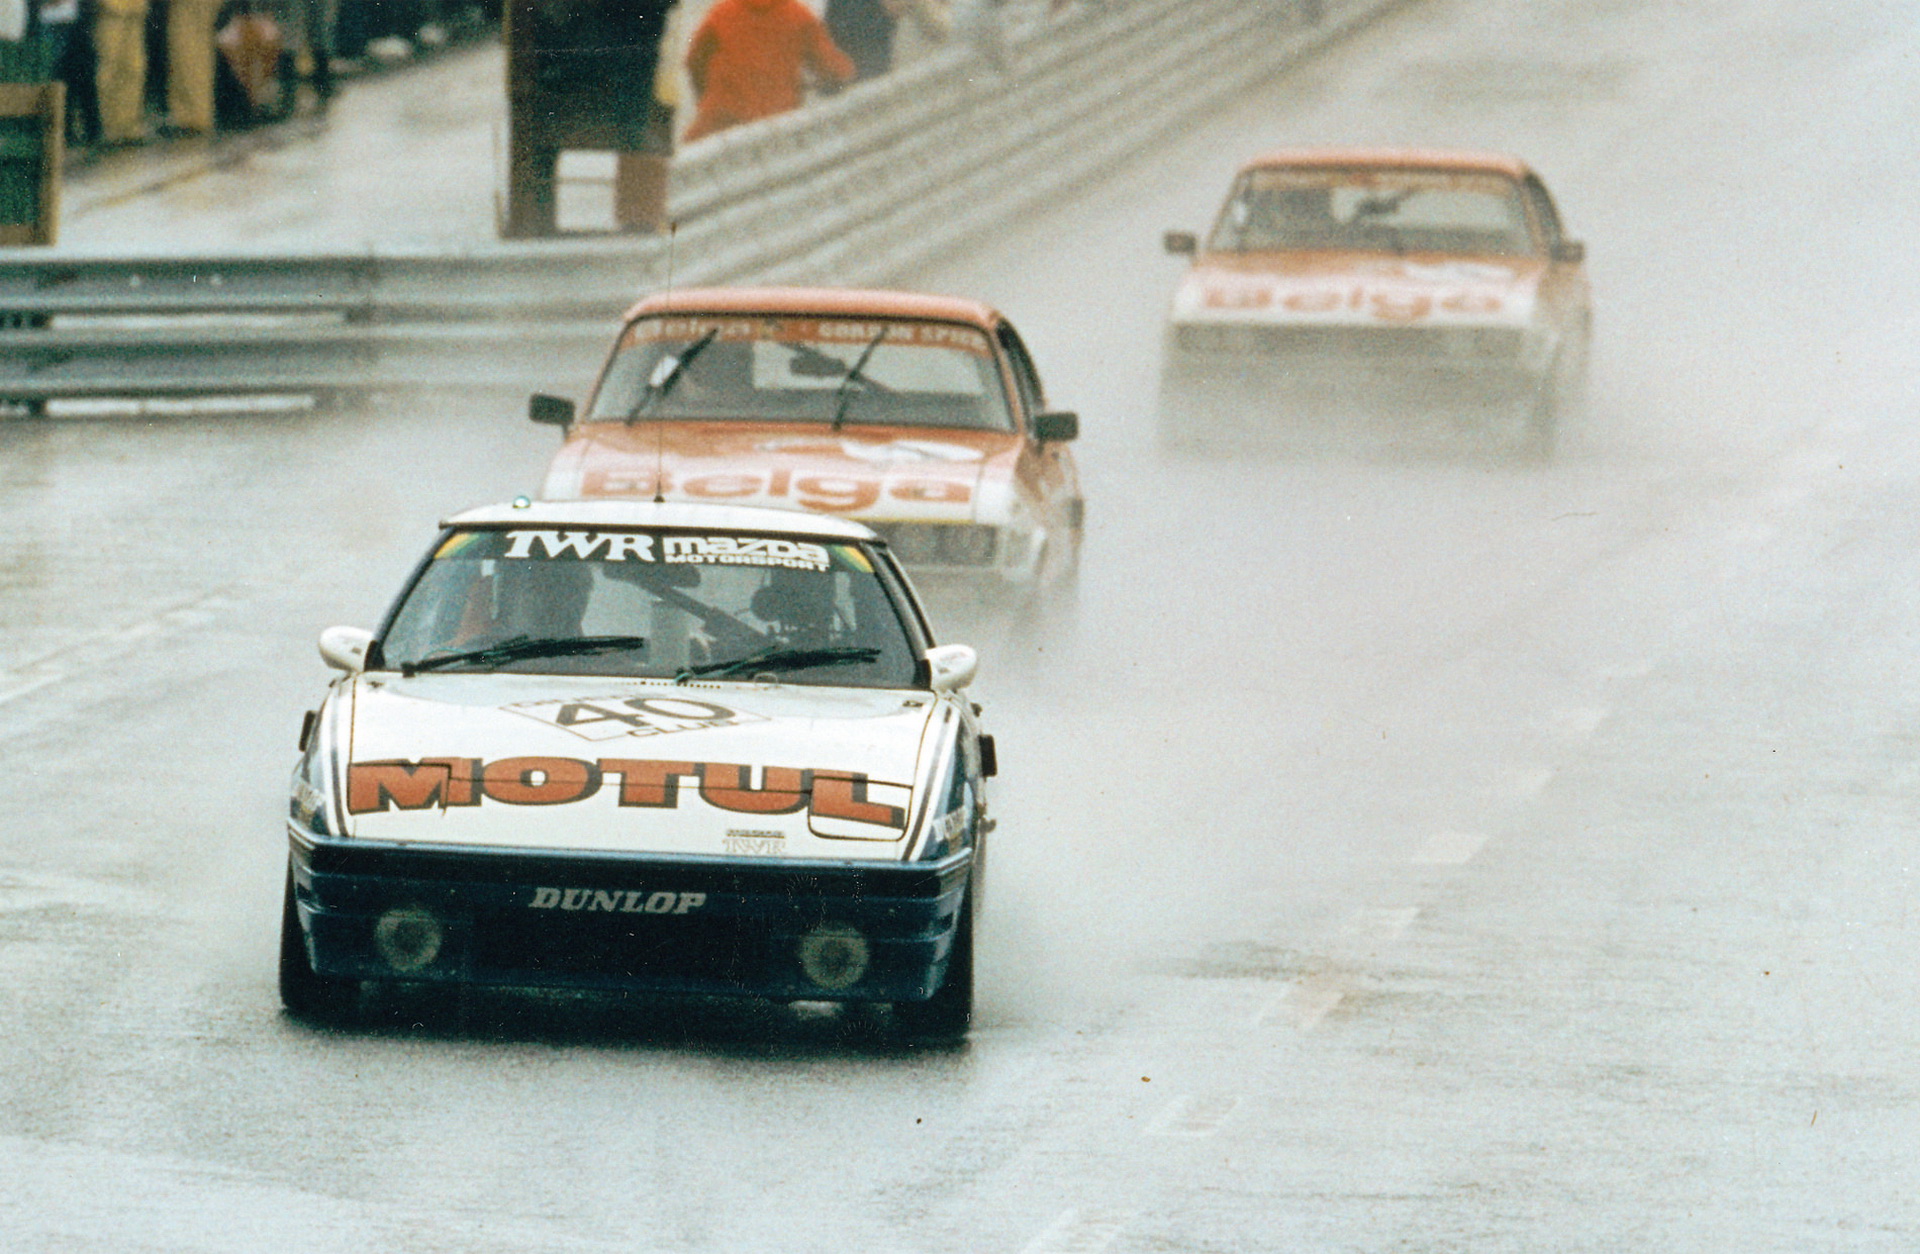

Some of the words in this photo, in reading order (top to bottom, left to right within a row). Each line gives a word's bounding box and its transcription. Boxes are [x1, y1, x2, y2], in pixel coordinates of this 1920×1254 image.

[580, 467, 972, 512] Belga
[504, 530, 655, 562] TWR
[665, 554, 829, 572] MOTORSPORT
[555, 698, 737, 727] 40
[347, 756, 906, 828] MOTUL
[528, 887, 707, 915] DUNLOP
